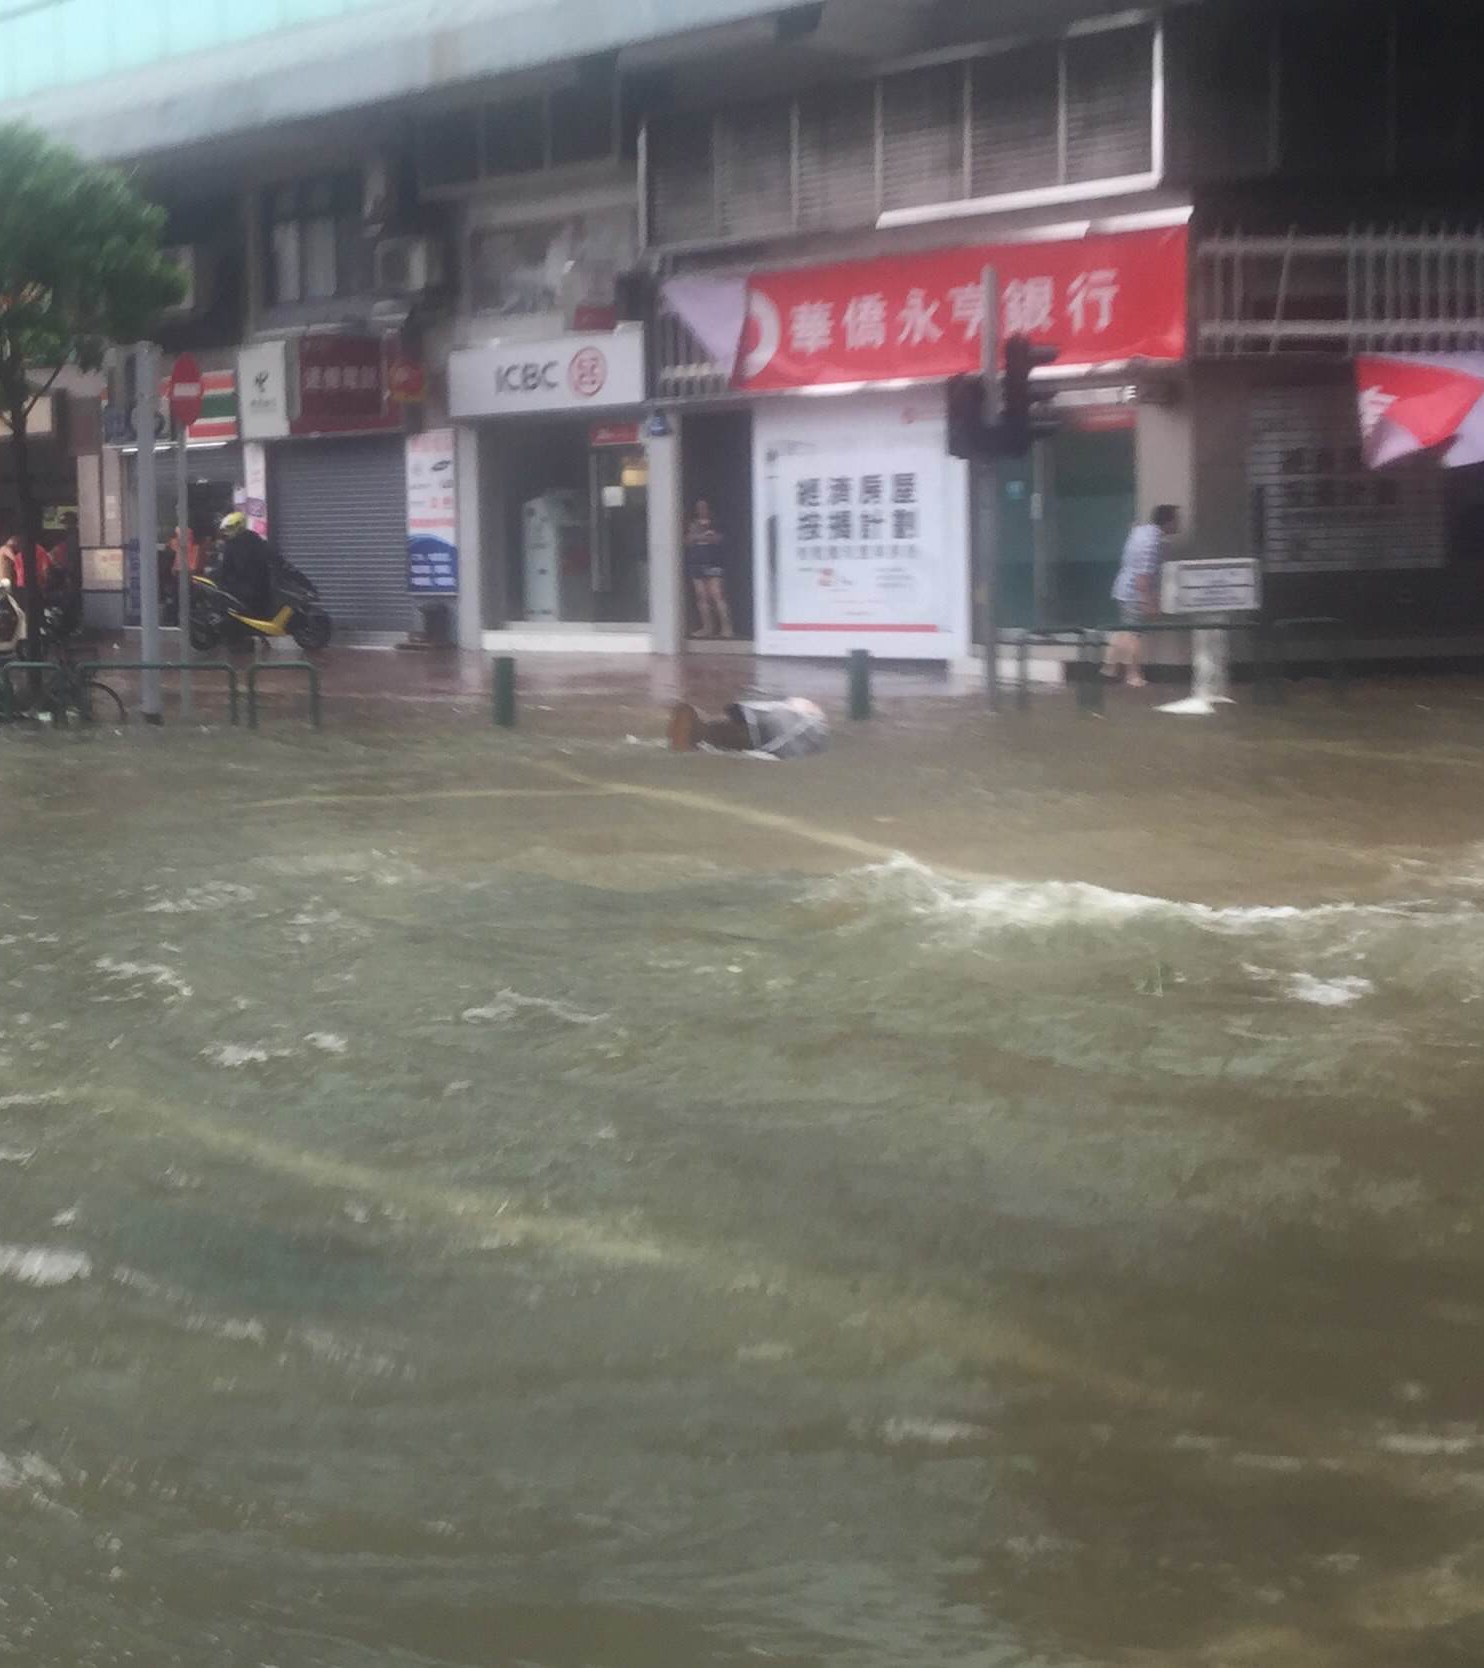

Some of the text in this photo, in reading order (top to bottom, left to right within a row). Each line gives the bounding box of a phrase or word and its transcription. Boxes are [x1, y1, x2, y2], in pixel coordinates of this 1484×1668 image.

[788, 267, 1121, 355] 華僑永亨銀行
[495, 360, 559, 394] ICBC
